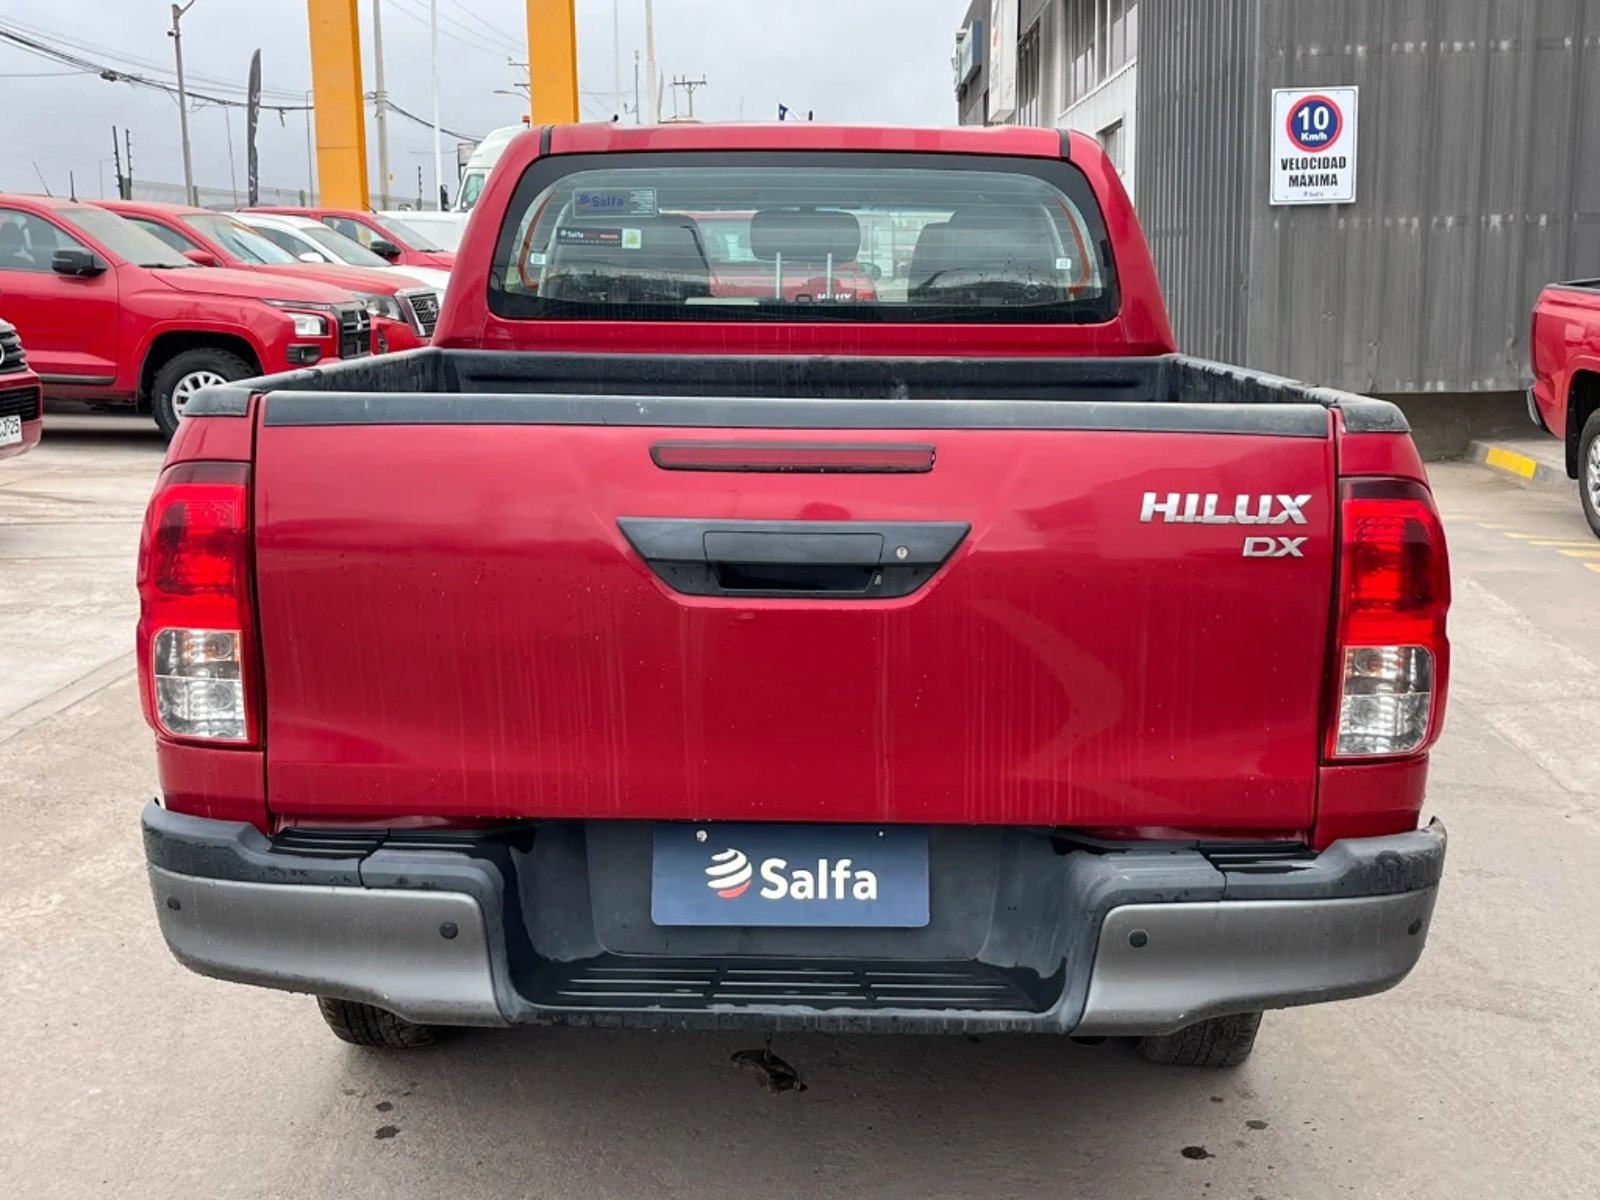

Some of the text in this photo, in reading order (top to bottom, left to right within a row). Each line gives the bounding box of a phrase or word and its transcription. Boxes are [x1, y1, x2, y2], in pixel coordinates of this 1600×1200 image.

[1298, 105, 1330, 131] 10
[1300, 132, 1328, 141] Km/h
[1280, 156, 1347, 171] VELOCIDAD
[1288, 172, 1338, 187] MÁXIMA
[592, 195, 624, 208] Salfa
[1139, 492, 1312, 524] HILUX
[1242, 536, 1308, 557] DX
[760, 857, 878, 900] Salfa
